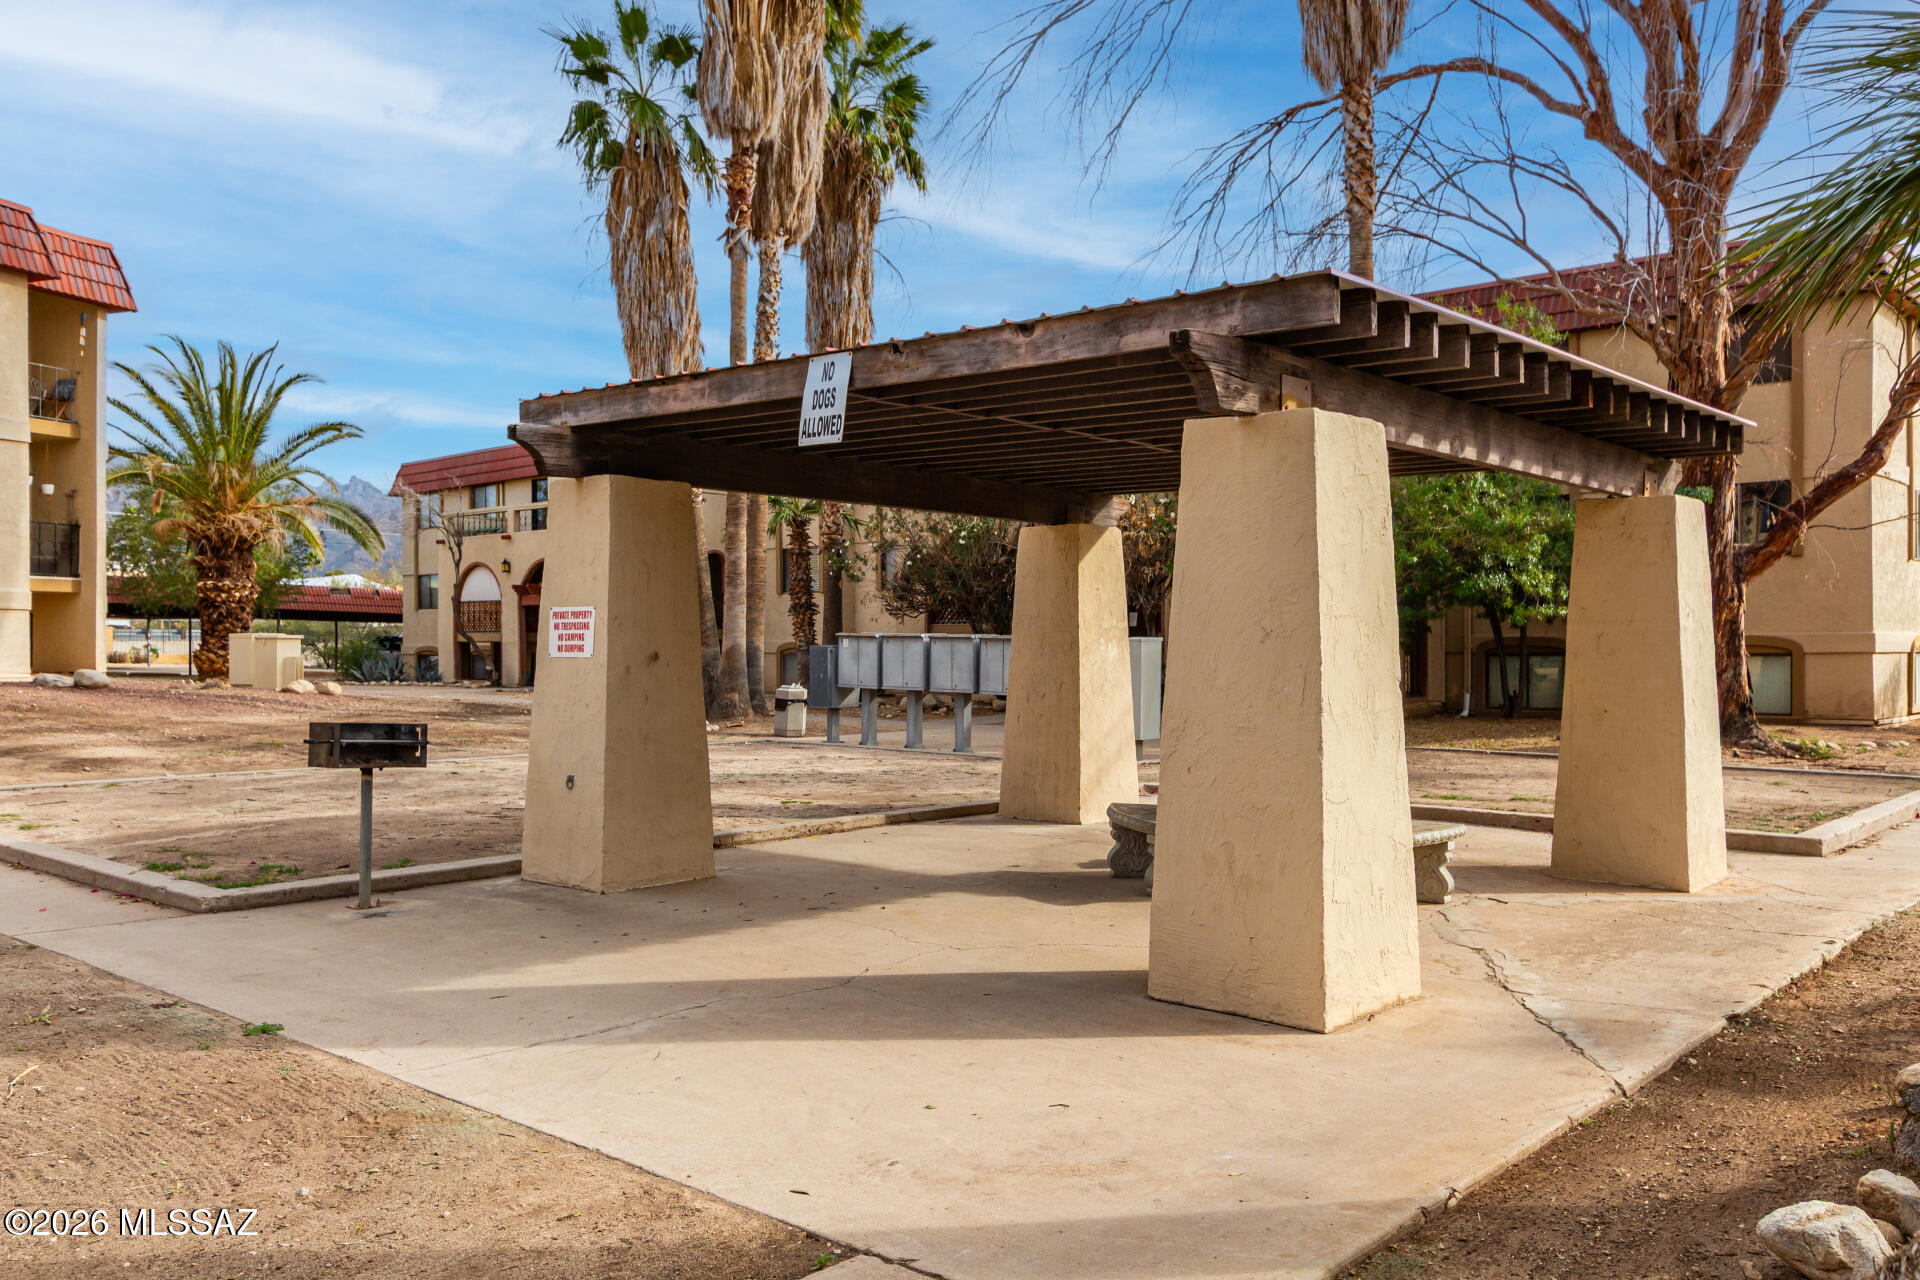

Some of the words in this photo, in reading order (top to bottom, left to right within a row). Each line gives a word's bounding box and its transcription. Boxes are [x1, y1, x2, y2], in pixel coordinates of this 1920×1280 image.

[822, 361, 835, 382] NO
[812, 387, 836, 410] DOGS
[801, 414, 842, 439] ALLOWED
[552, 611, 569, 619] PRIVATE
[570, 611, 592, 619] PROPERTY
[554, 622, 559, 630] NO
[561, 622, 589, 630] TRESPASSING
[558, 633, 563, 641] NO
[565, 633, 584, 641] CAMPING
[558, 644, 563, 652] NO
[564, 644, 584, 652] DUMPING
